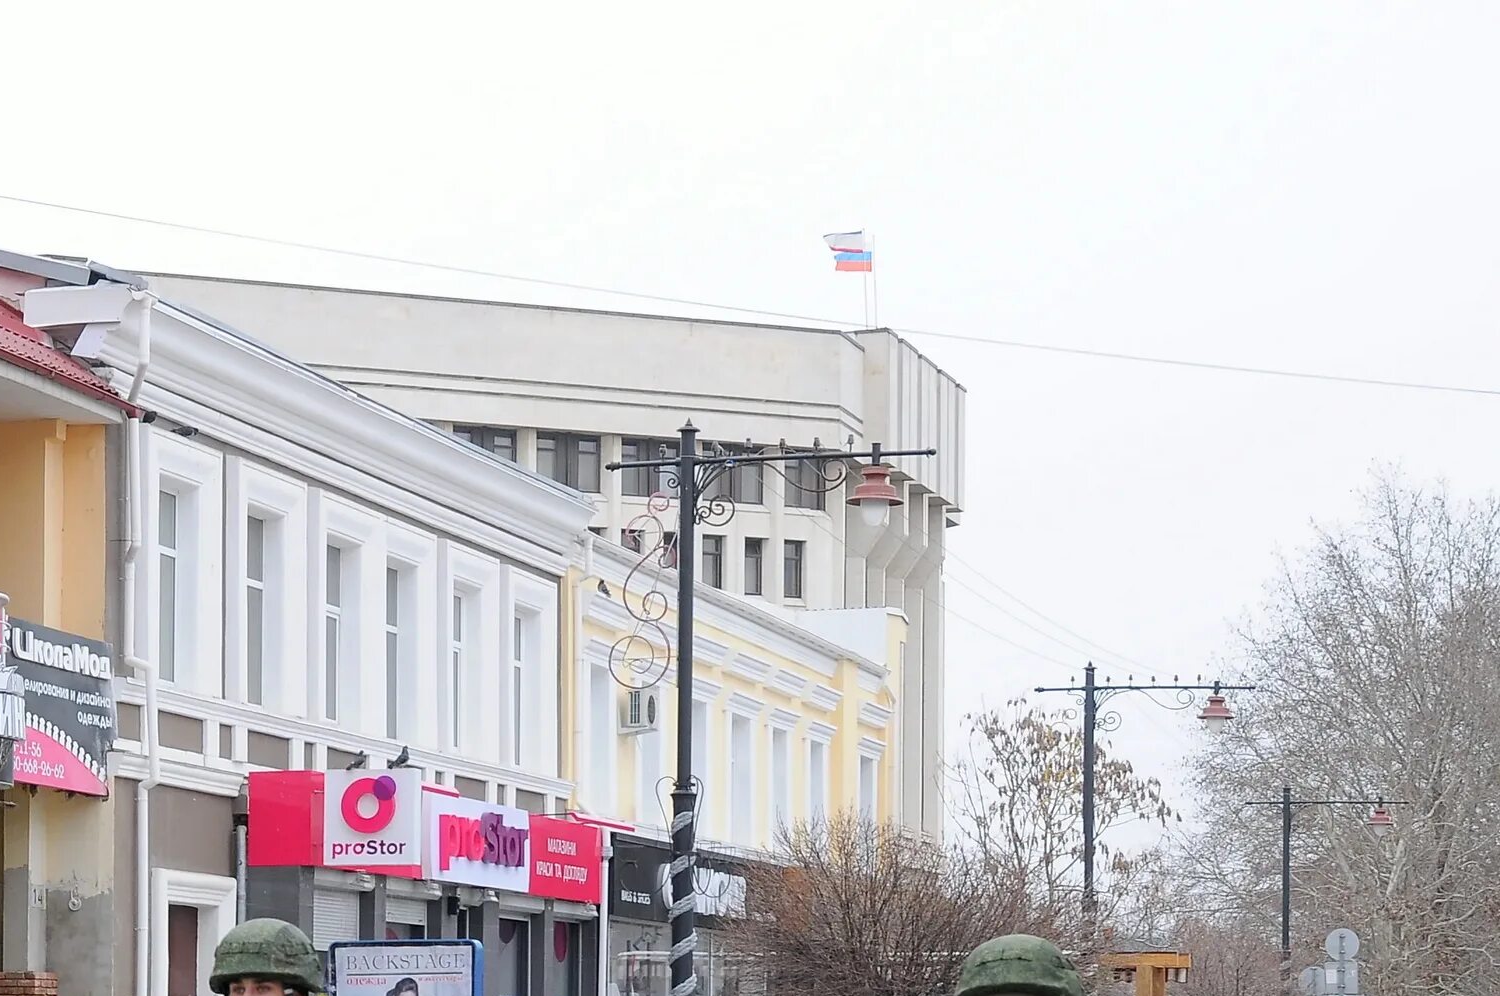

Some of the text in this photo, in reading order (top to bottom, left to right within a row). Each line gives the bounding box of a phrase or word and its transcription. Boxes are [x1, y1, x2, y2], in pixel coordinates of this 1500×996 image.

[77, 711, 113, 730] одежды
[331, 839, 407, 859] proStor
[438, 811, 530, 871] proStor
[346, 953, 466, 970] BACKSTAGE
